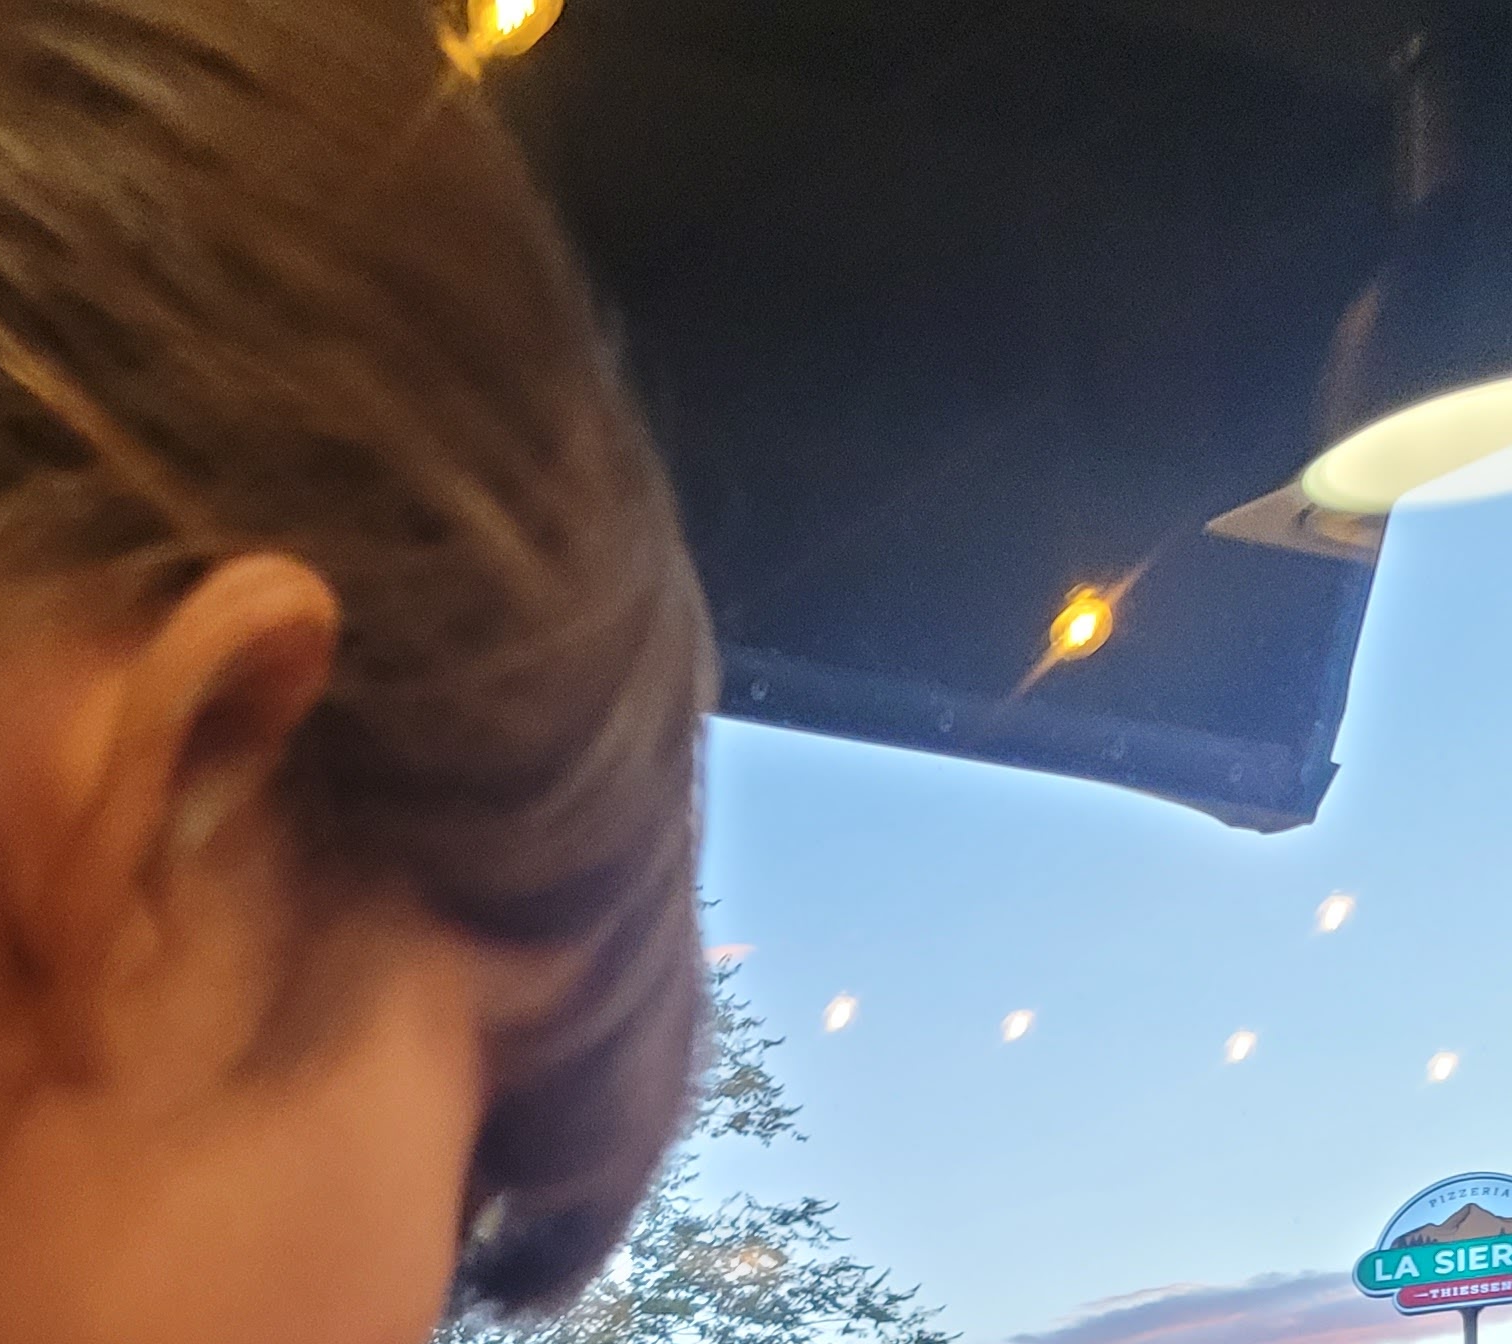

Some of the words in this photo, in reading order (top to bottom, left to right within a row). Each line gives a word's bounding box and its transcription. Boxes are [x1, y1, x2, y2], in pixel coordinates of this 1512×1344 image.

[1429, 1187, 1510, 1208] PIZZERIA
[1375, 1255, 1420, 1282] LA
[1429, 1280, 1512, 1299] THIESSEN
